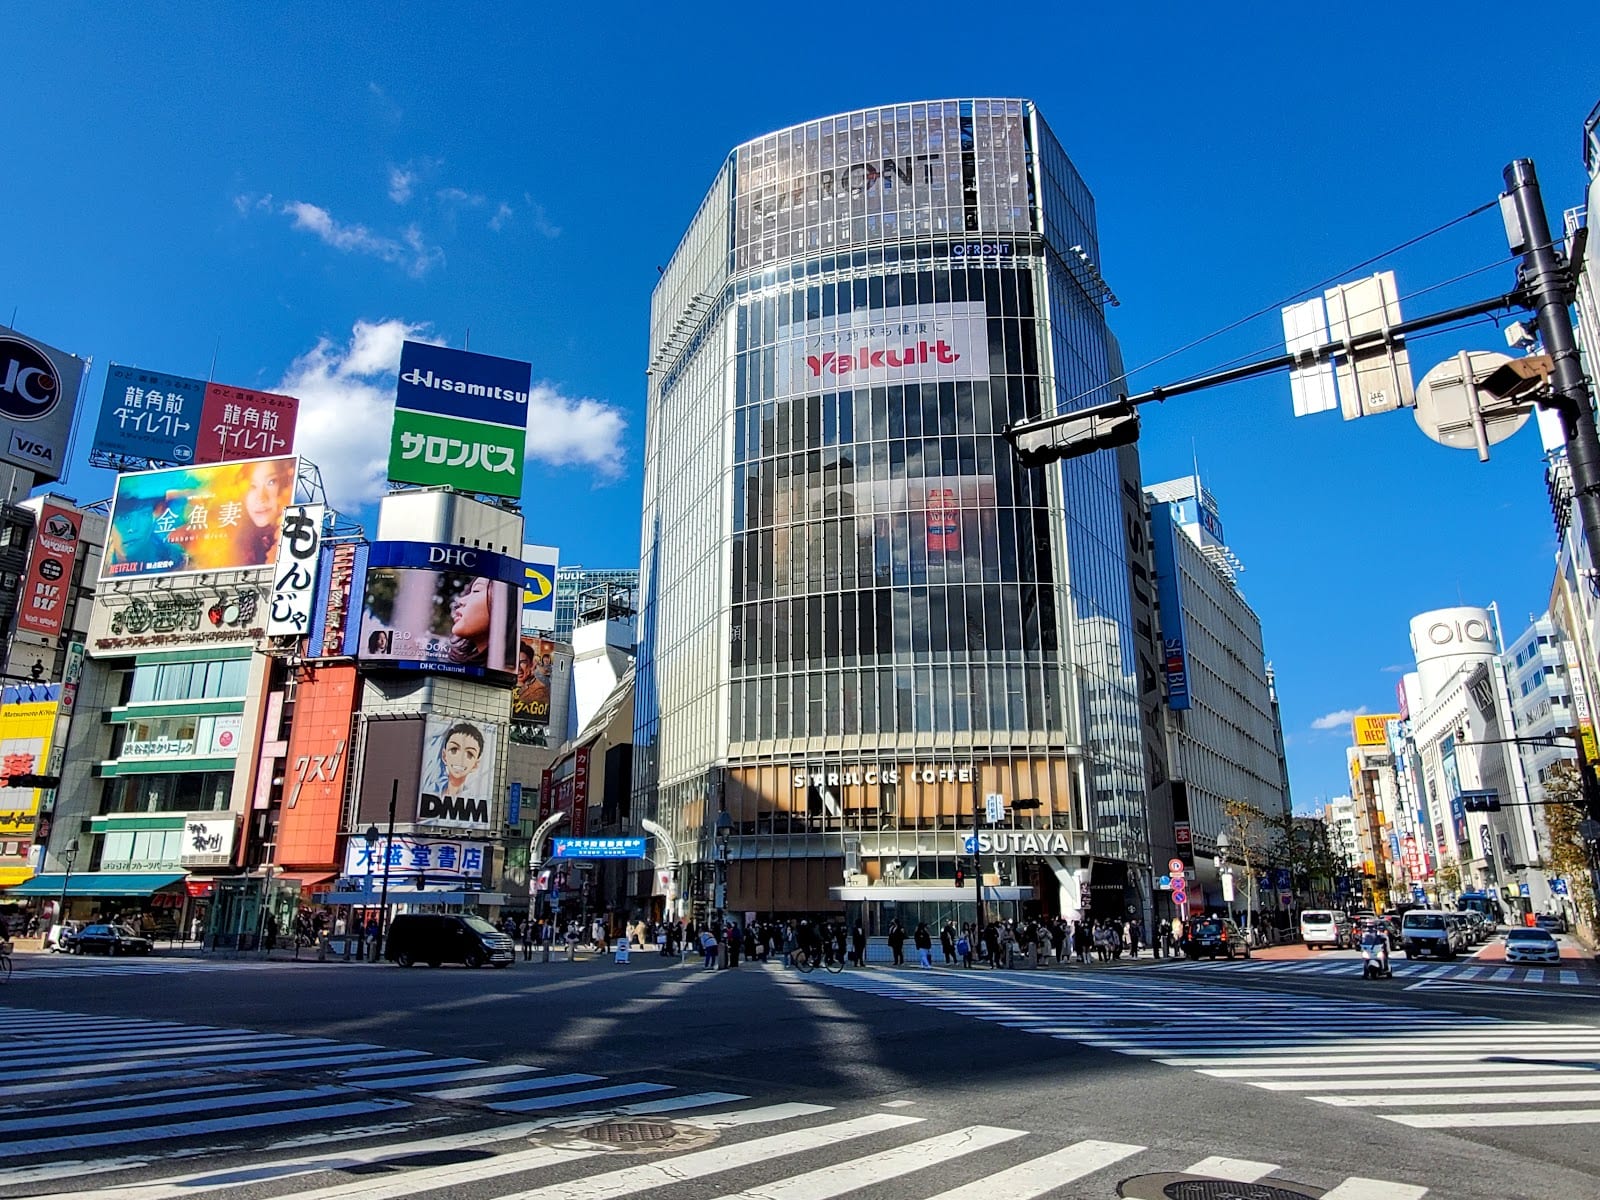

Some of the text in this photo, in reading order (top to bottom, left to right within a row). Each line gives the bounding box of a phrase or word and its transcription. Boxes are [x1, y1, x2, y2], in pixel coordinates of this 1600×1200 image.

[953, 244, 1009, 256] QFRONT
[807, 340, 961, 377] Yakult
[124, 385, 184, 415] 龍角散
[401, 367, 528, 405] Hisamitsu
[113, 407, 191, 437] ダイレクト
[224, 403, 280, 432] 龍角散
[15, 436, 53, 461] VISA
[213, 424, 286, 453] ダイレクト
[400, 431, 516, 476] サロンパス
[154, 500, 242, 534] 金魚妻
[109, 562, 137, 574] NETFLIX
[270, 507, 318, 631] もんじゃ
[428, 546, 477, 569] DHC
[36, 583, 60, 597] B1F
[557, 572, 586, 580] HULIC
[33, 596, 58, 611] B2F
[438, 664, 466, 674] Channel
[287, 740, 346, 809] クスリ
[575, 754, 587, 803] カラオケ
[794, 769, 898, 788] STARBUCKS
[420, 793, 489, 823] DMM
[356, 840, 482, 869] 大盛堂書店
[961, 833, 1069, 852] TSUTAYA
